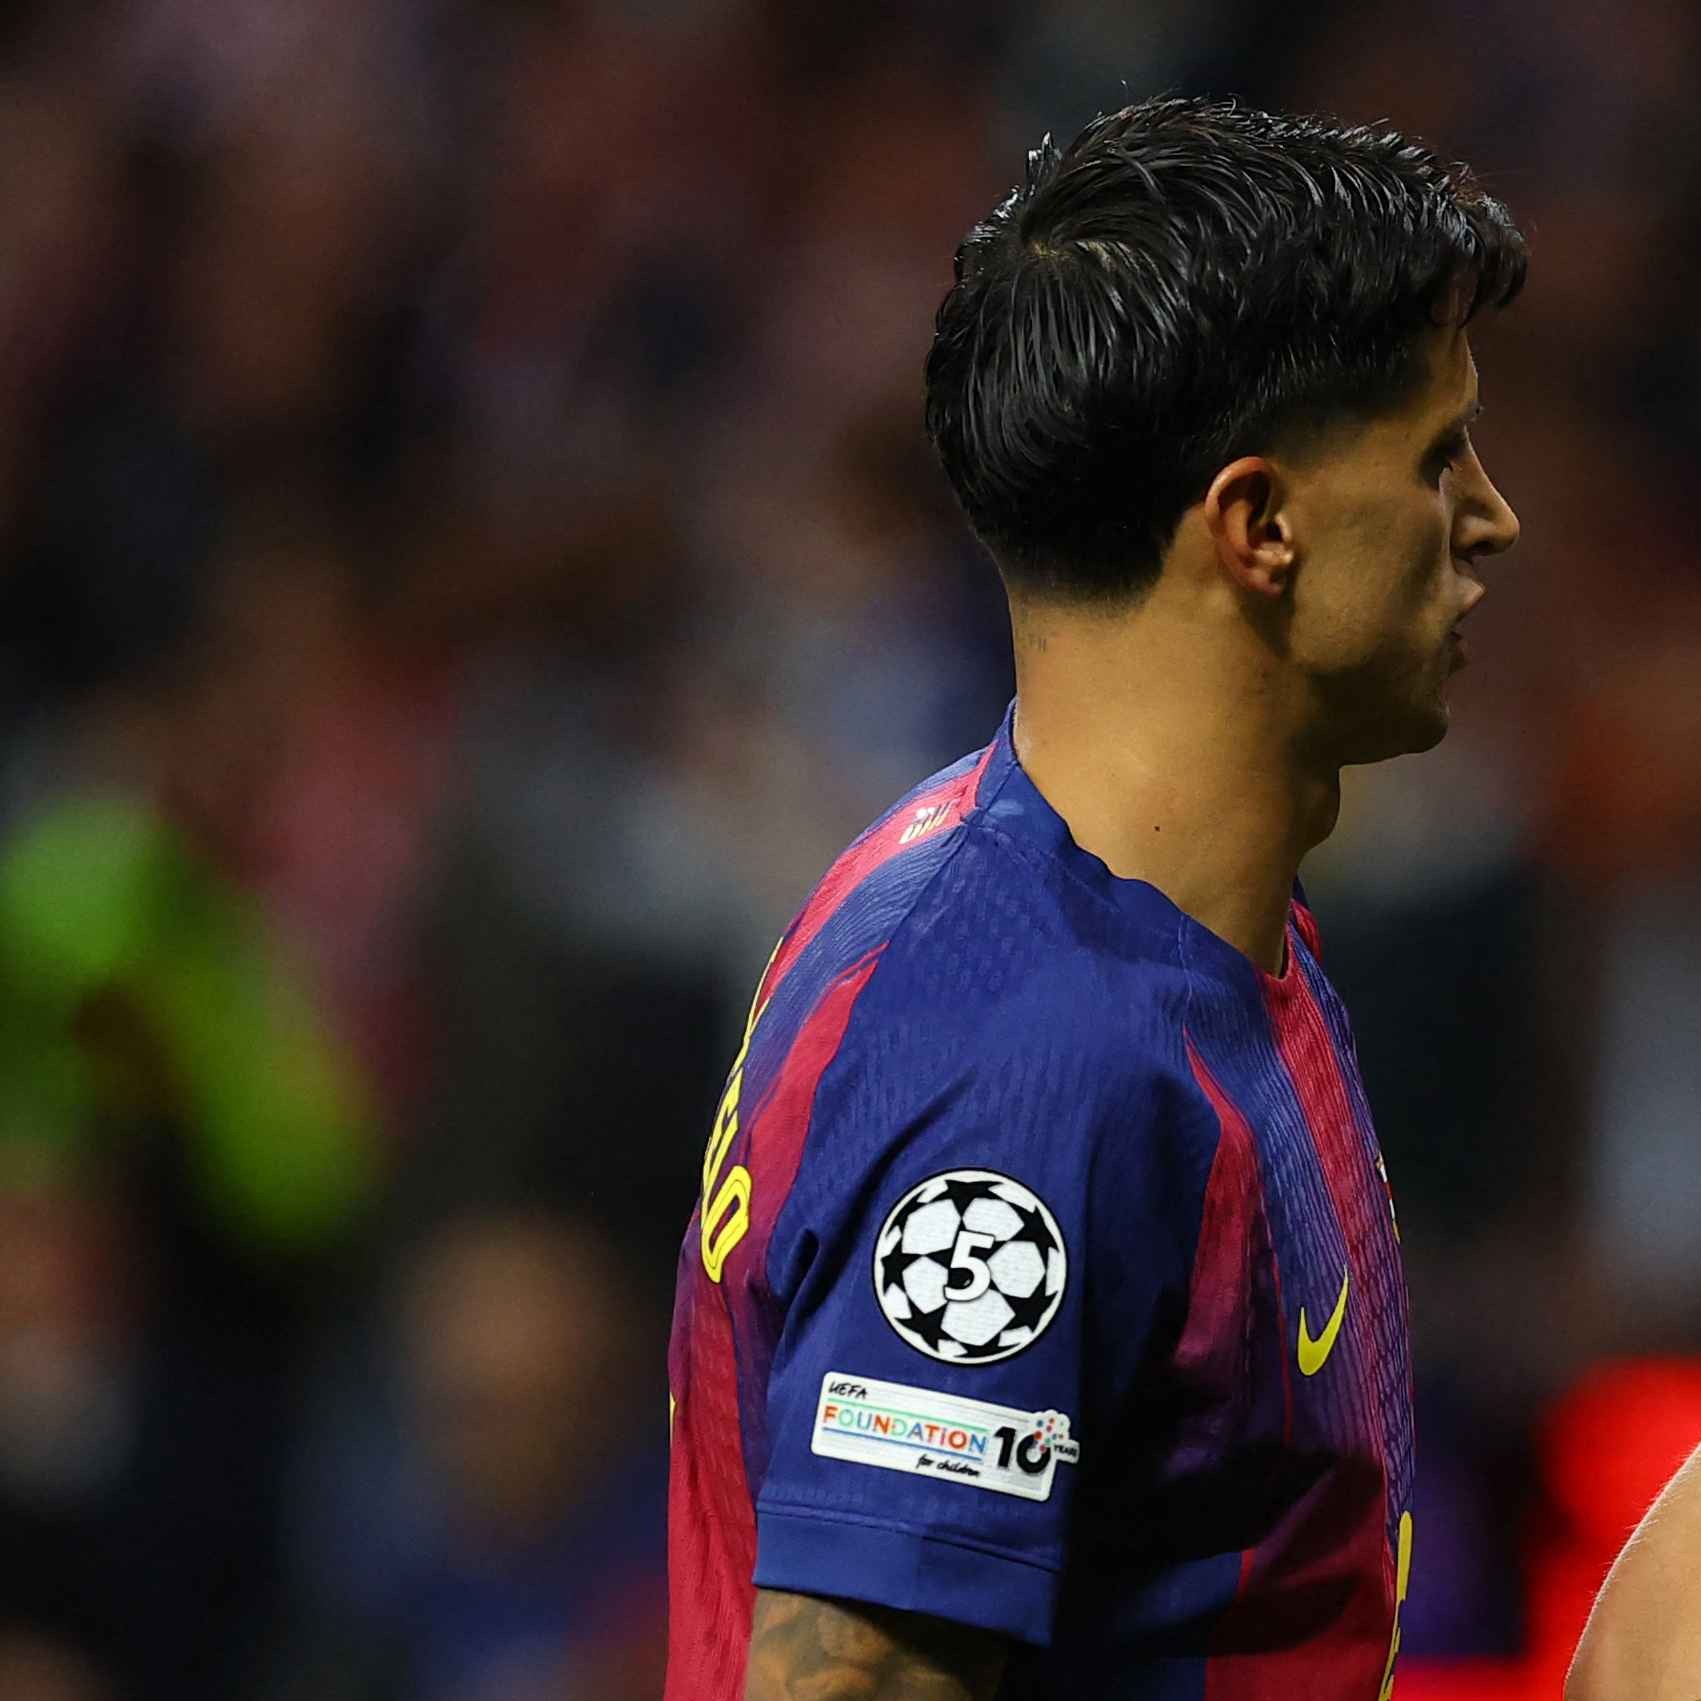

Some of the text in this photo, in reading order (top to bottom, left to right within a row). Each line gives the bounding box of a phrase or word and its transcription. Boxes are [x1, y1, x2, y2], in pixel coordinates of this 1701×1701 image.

[943, 1231, 994, 1301] 5
[828, 1382, 868, 1400] UEFA
[823, 1405, 988, 1455] FOUNDATION
[993, 1426, 1051, 1475] 10
[916, 1453, 981, 1478] for children
